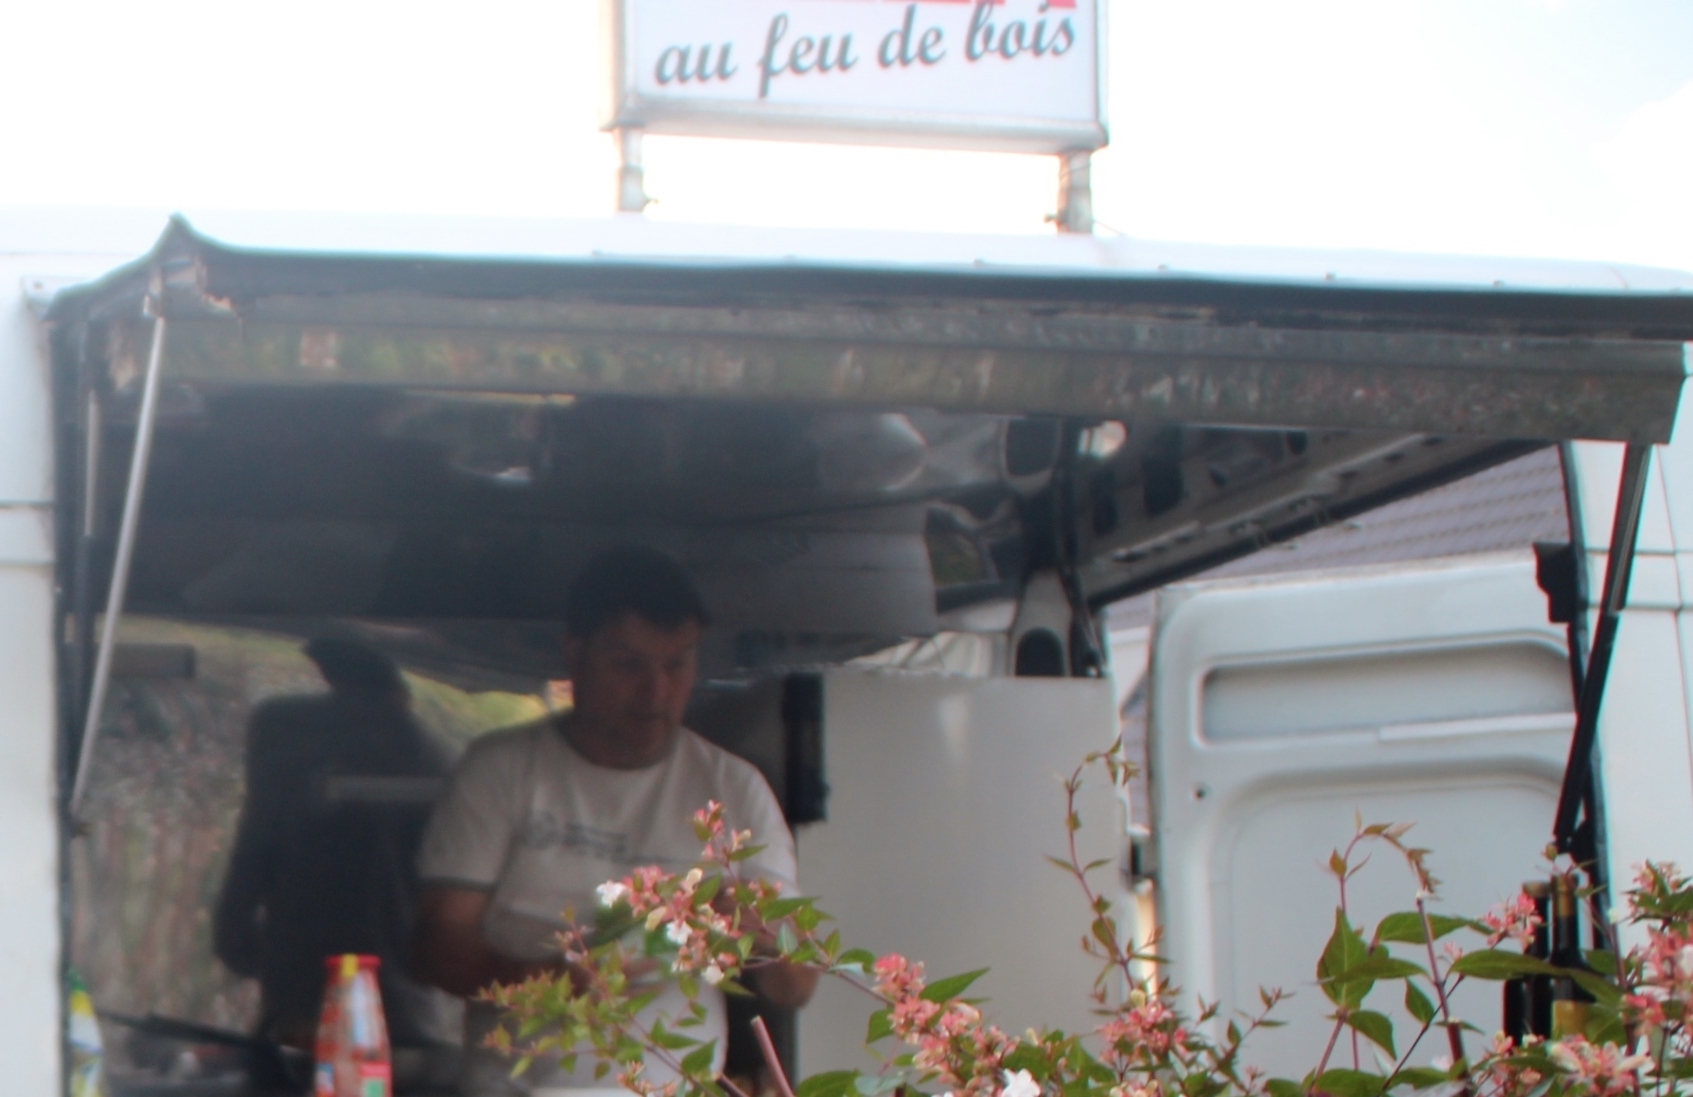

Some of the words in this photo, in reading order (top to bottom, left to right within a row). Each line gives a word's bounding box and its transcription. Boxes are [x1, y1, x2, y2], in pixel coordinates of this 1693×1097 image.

[654, 41, 736, 86] au
[757, 13, 857, 99] feu
[877, 2, 946, 69] de
[964, 0, 1076, 62] bois
